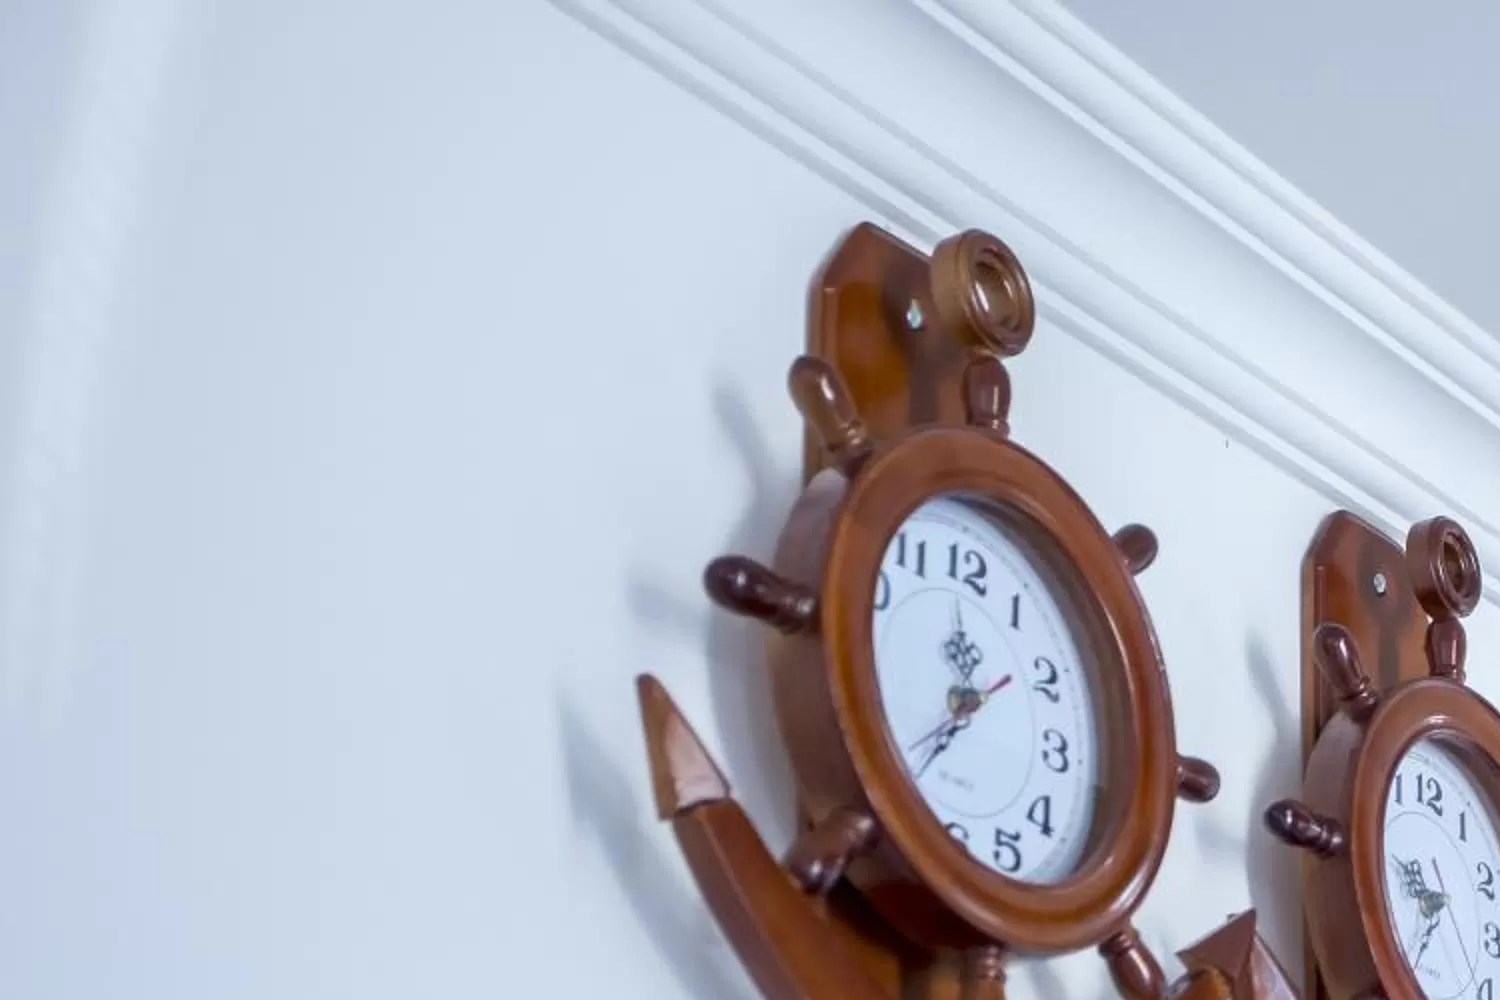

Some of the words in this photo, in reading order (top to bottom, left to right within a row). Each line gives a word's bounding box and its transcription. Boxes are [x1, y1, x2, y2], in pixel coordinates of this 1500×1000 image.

[947, 543, 987, 598] 12
[1010, 592, 1021, 630] 1
[1034, 656, 1060, 703] 2
[1041, 728, 1069, 774] 3
[1026, 795, 1054, 837] 4
[1416, 773, 1443, 817] 12
[1458, 811, 1468, 842] 1
[993, 827, 1022, 873] 5
[1477, 861, 1496, 901] 2
